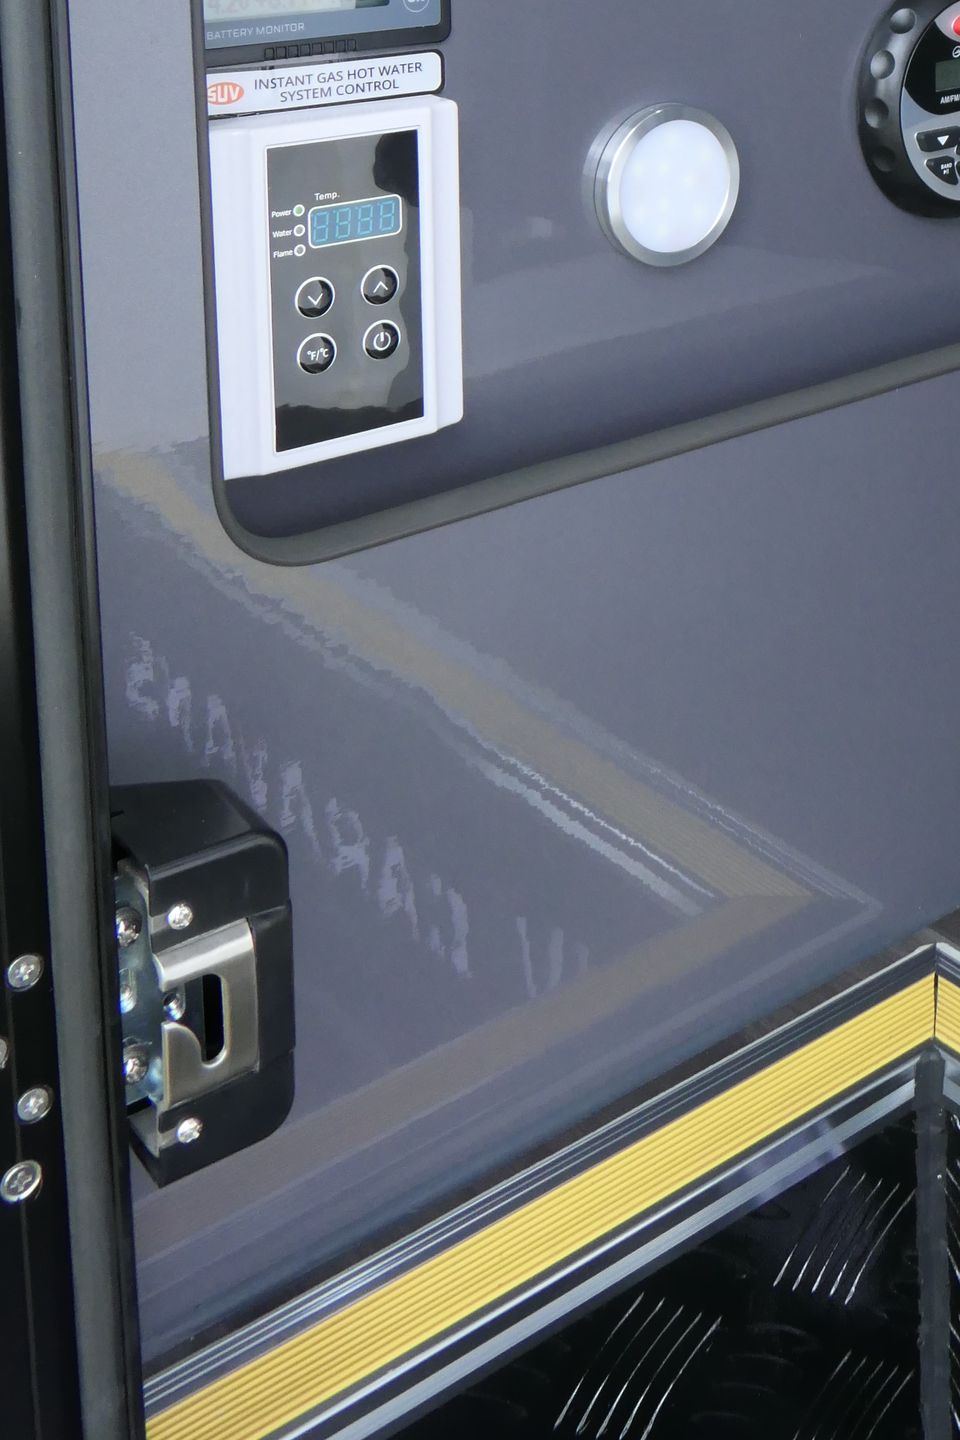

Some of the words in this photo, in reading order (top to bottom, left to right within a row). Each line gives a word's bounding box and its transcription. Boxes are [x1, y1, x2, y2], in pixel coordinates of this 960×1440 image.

[206, 26, 255, 40] BATTERY
[256, 22, 305, 35] MONITOR
[208, 83, 242, 104] SUV
[254, 74, 313, 90] INSTANT
[317, 70, 344, 83] GAS
[347, 66, 376, 80] HOT
[378, 62, 422, 76] WATER
[280, 87, 332, 103] SYSTEM
[336, 80, 399, 96] CONTROL
[940, 162, 953, 170] BAND
[313, 191, 340, 201] Temp.
[271, 209, 292, 218] Power
[272, 229, 293, 238] Water
[273, 249, 293, 258] Flame
